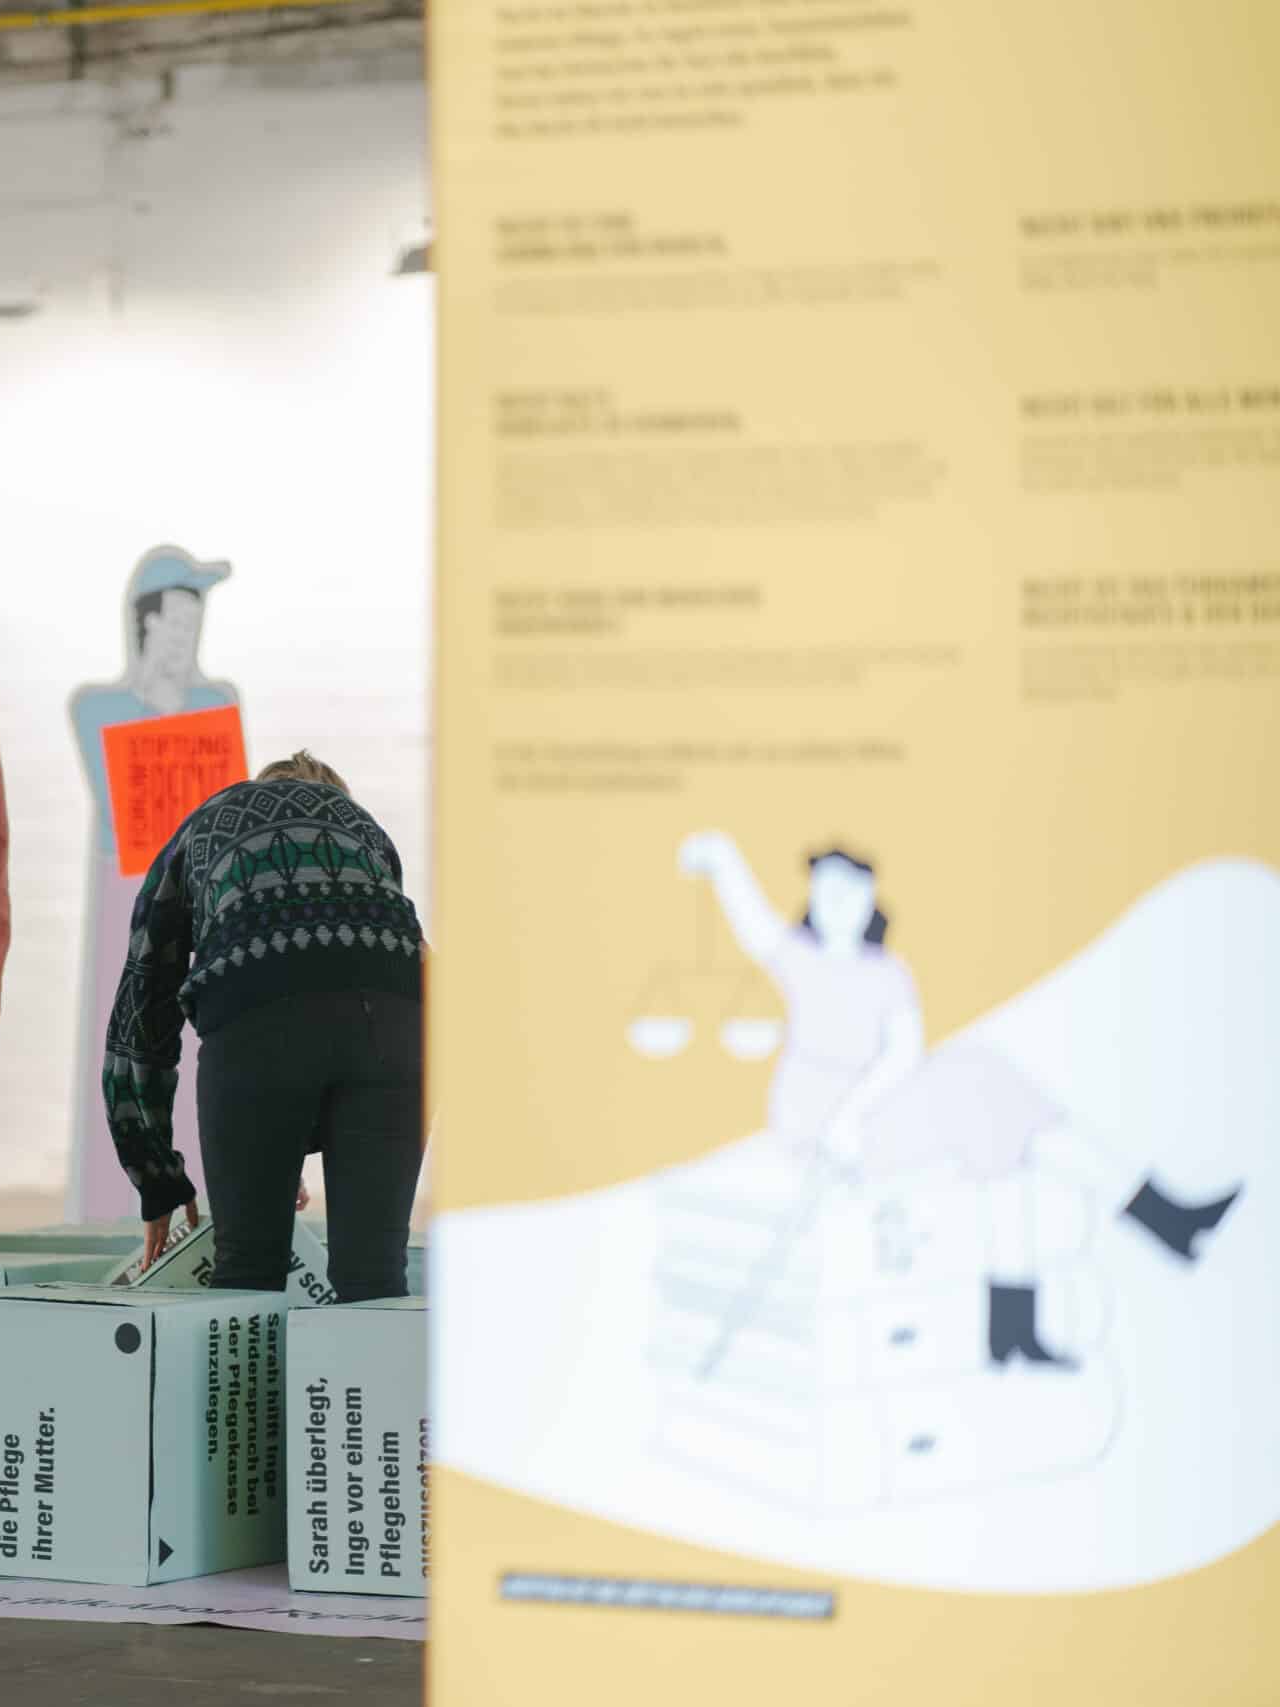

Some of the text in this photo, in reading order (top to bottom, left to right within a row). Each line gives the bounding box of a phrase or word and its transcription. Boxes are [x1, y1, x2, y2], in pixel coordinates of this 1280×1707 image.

[206, 1319, 221, 1462] einzulegen.
[226, 1317, 240, 1516] der Pflegekasse
[246, 1313, 260, 1516] Widerspruch bei
[266, 1312, 280, 1384] Sarah
[0, 1433, 24, 1558] die Pflege
[32, 1406, 55, 1561] ihrer Mutter.
[304, 1377, 329, 1574] Sarah überlegt,
[343, 1386, 369, 1576] Inge vor einem
[379, 1431, 404, 1578] Pflegeheim
